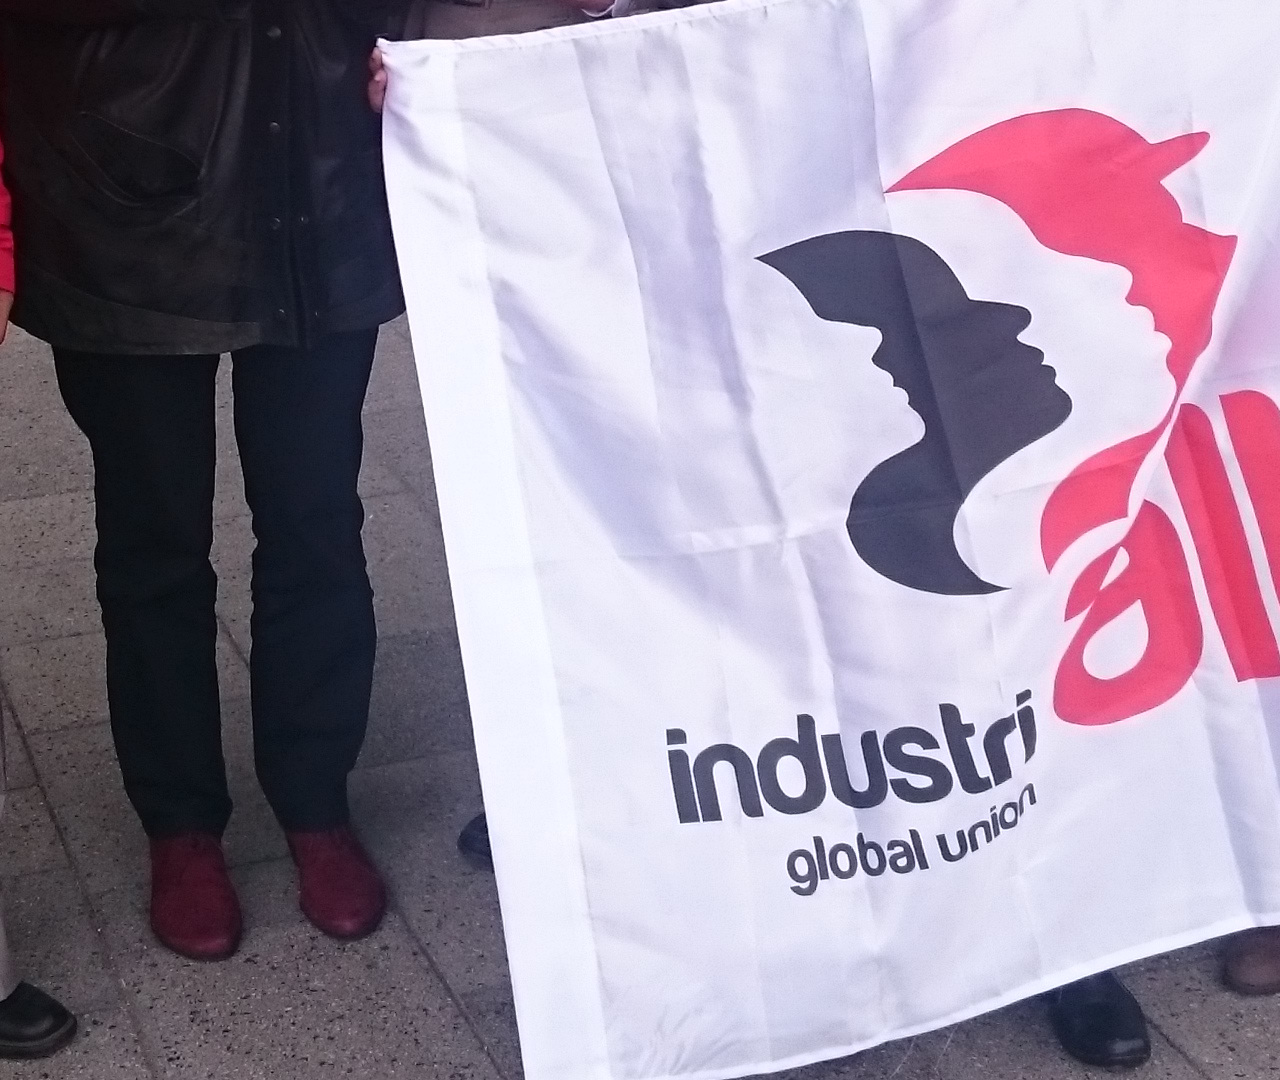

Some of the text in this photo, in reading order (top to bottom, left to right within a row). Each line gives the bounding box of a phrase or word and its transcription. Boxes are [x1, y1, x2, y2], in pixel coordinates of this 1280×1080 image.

[666, 688, 1037, 824] industri
[786, 781, 1037, 897] global union
